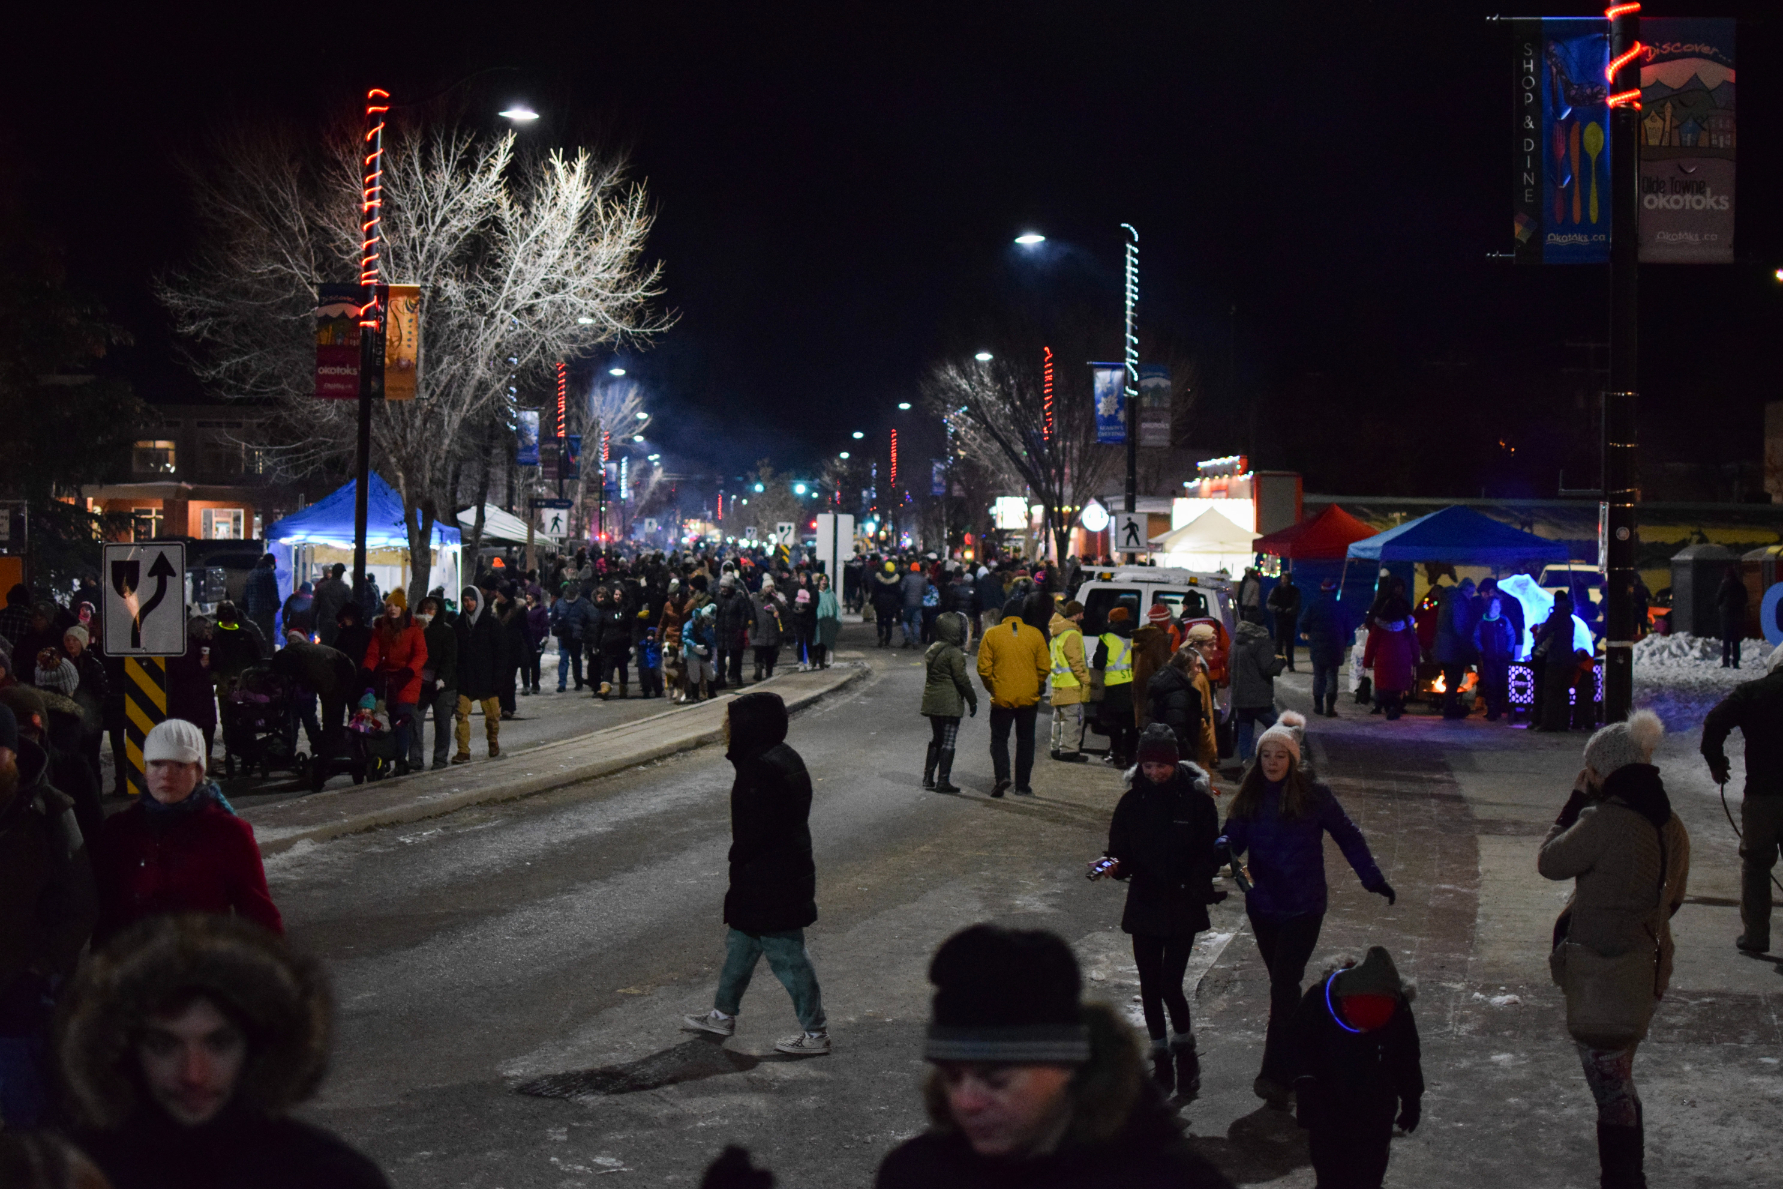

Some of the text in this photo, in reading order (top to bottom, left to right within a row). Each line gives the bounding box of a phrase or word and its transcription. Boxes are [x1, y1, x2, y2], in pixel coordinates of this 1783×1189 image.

[1522, 42, 1536, 106] SHOP
[1523, 138, 1535, 203] DINE
[1642, 177, 1706, 194] Olde Towne
[1643, 187, 1730, 210] okotoks
